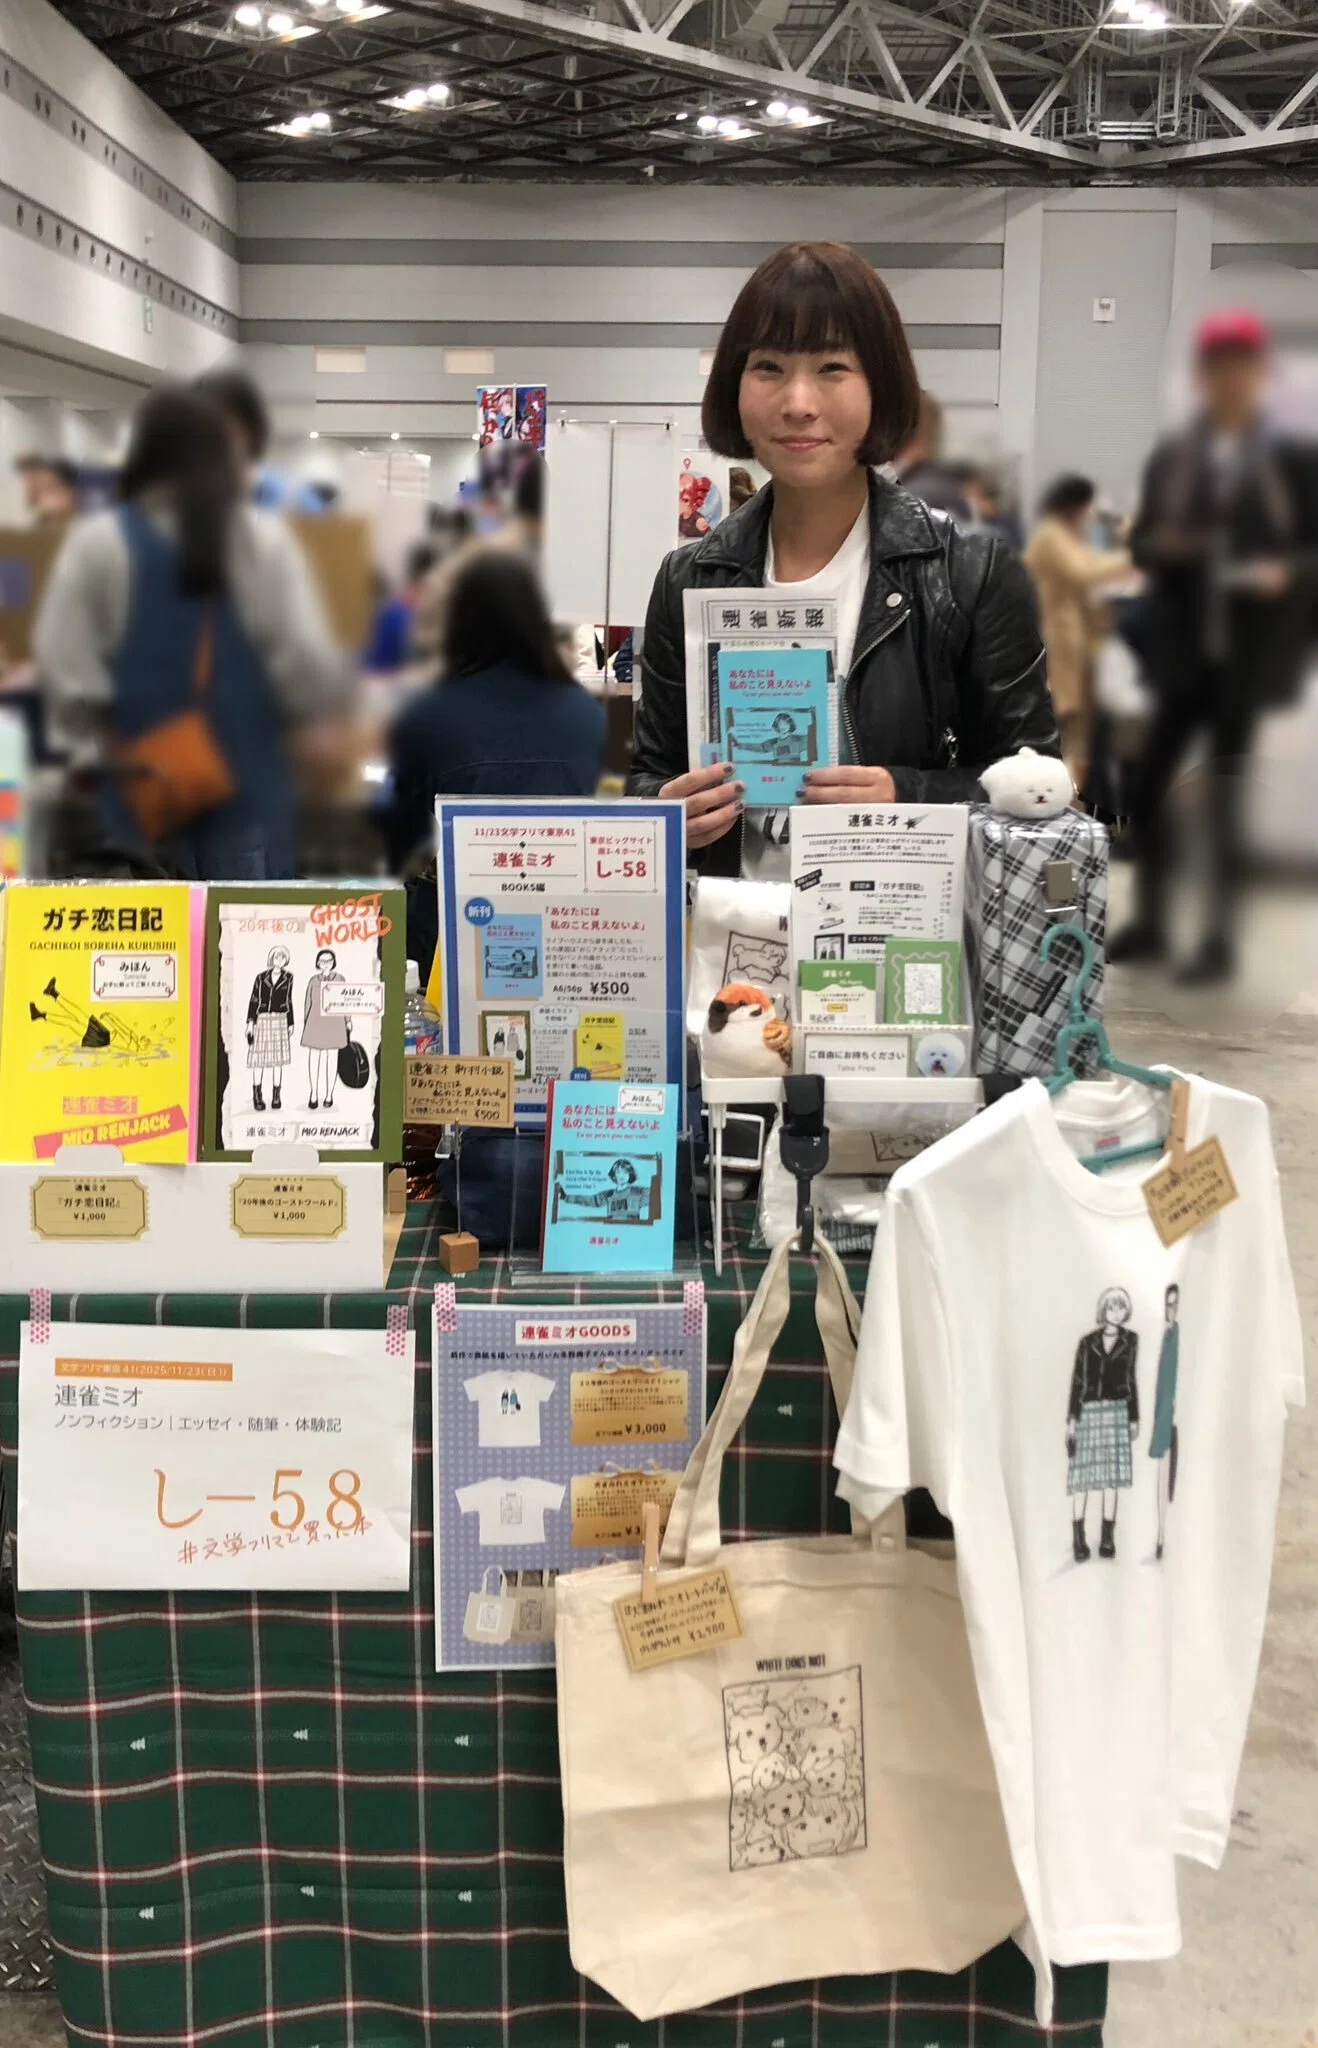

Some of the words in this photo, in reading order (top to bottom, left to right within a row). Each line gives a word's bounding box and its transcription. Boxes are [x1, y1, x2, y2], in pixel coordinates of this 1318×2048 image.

[728, 669, 775, 677] あなたには
[728, 680, 812, 690] 私のこと見えないよ
[848, 813, 900, 828] 連雀ミオ
[474, 827, 575, 838] 11/23文学フリマ東京41
[589, 836, 653, 845] 東京ビッグサイト
[493, 852, 556, 868] 連雀ミオ
[597, 860, 647, 878] し-58
[310, 892, 383, 927] GHOST
[467, 905, 491, 917] 新刊
[43, 908, 164, 933] ガチ恋日記
[239, 919, 304, 933] 20年後の
[550, 920, 646, 931] 私のこと見えないよ」
[315, 915, 393, 948] WORLD
[30, 941, 79, 950] GACHIKOI
[83, 941, 126, 950] SOREHA
[119, 960, 152, 973] みほん
[340, 988, 365, 997] みほん
[590, 982, 630, 995] ¥500
[808, 1050, 905, 1060] ご自由にお持ちください
[837, 1064, 855, 1072] Take
[858, 1064, 876, 1072] Free
[631, 1095, 652, 1103] みほん
[563, 1104, 617, 1116] あなたには
[63, 1128, 94, 1146] MIO
[97, 1114, 171, 1143] RENJACK
[562, 1118, 660, 1131] 私のこと見えないよ
[245, 1126, 287, 1138] 連雀ミオ
[301, 1126, 317, 1137] MIO
[319, 1126, 360, 1137] RENJACK
[73, 1212, 106, 1221] ¥1,000
[273, 1211, 306, 1221] ¥1,000
[521, 1324, 631, 1340] 連雀ミオGOODS
[54, 1383, 143, 1408] 連雀ミオ
